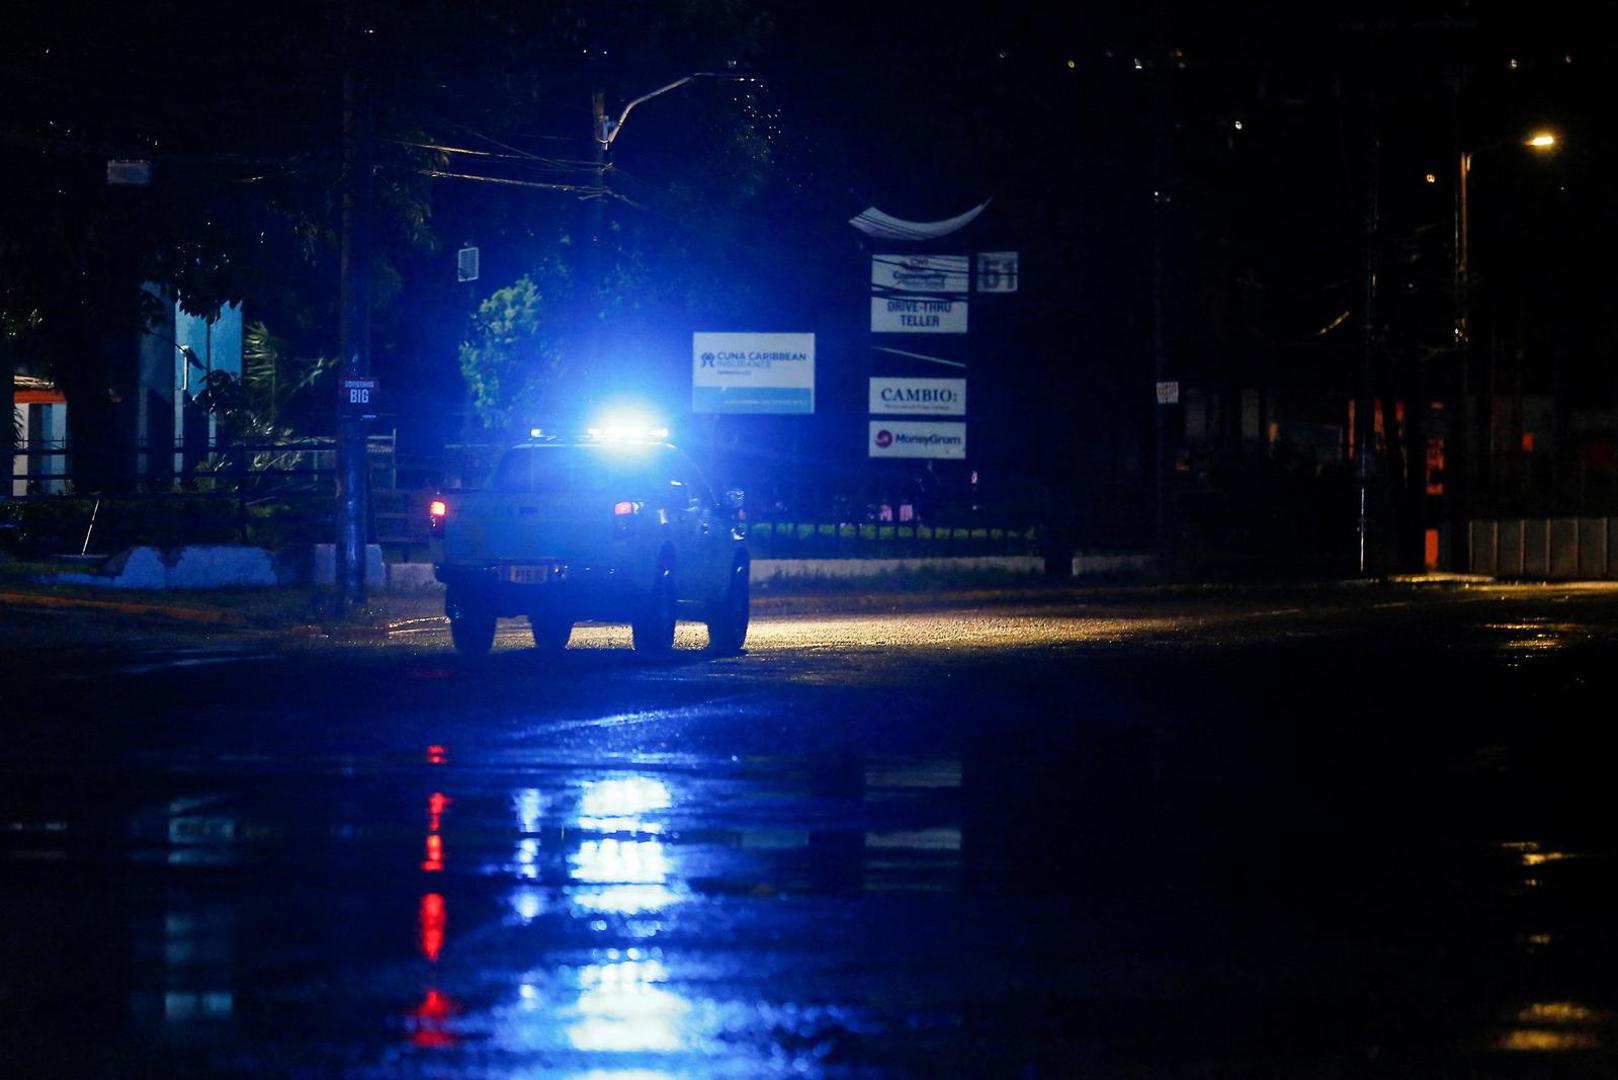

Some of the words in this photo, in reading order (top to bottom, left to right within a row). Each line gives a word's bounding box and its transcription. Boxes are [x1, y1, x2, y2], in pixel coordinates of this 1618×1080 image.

[888, 302, 951, 313] DRIVE-THRU
[900, 315, 940, 327] TELLER
[717, 352, 746, 360] CUNA
[748, 352, 807, 361] CARIBBEAN
[350, 388, 369, 403] BIG
[881, 388, 958, 402] CAMBIO:
[896, 433, 961, 446] MoneyGram
